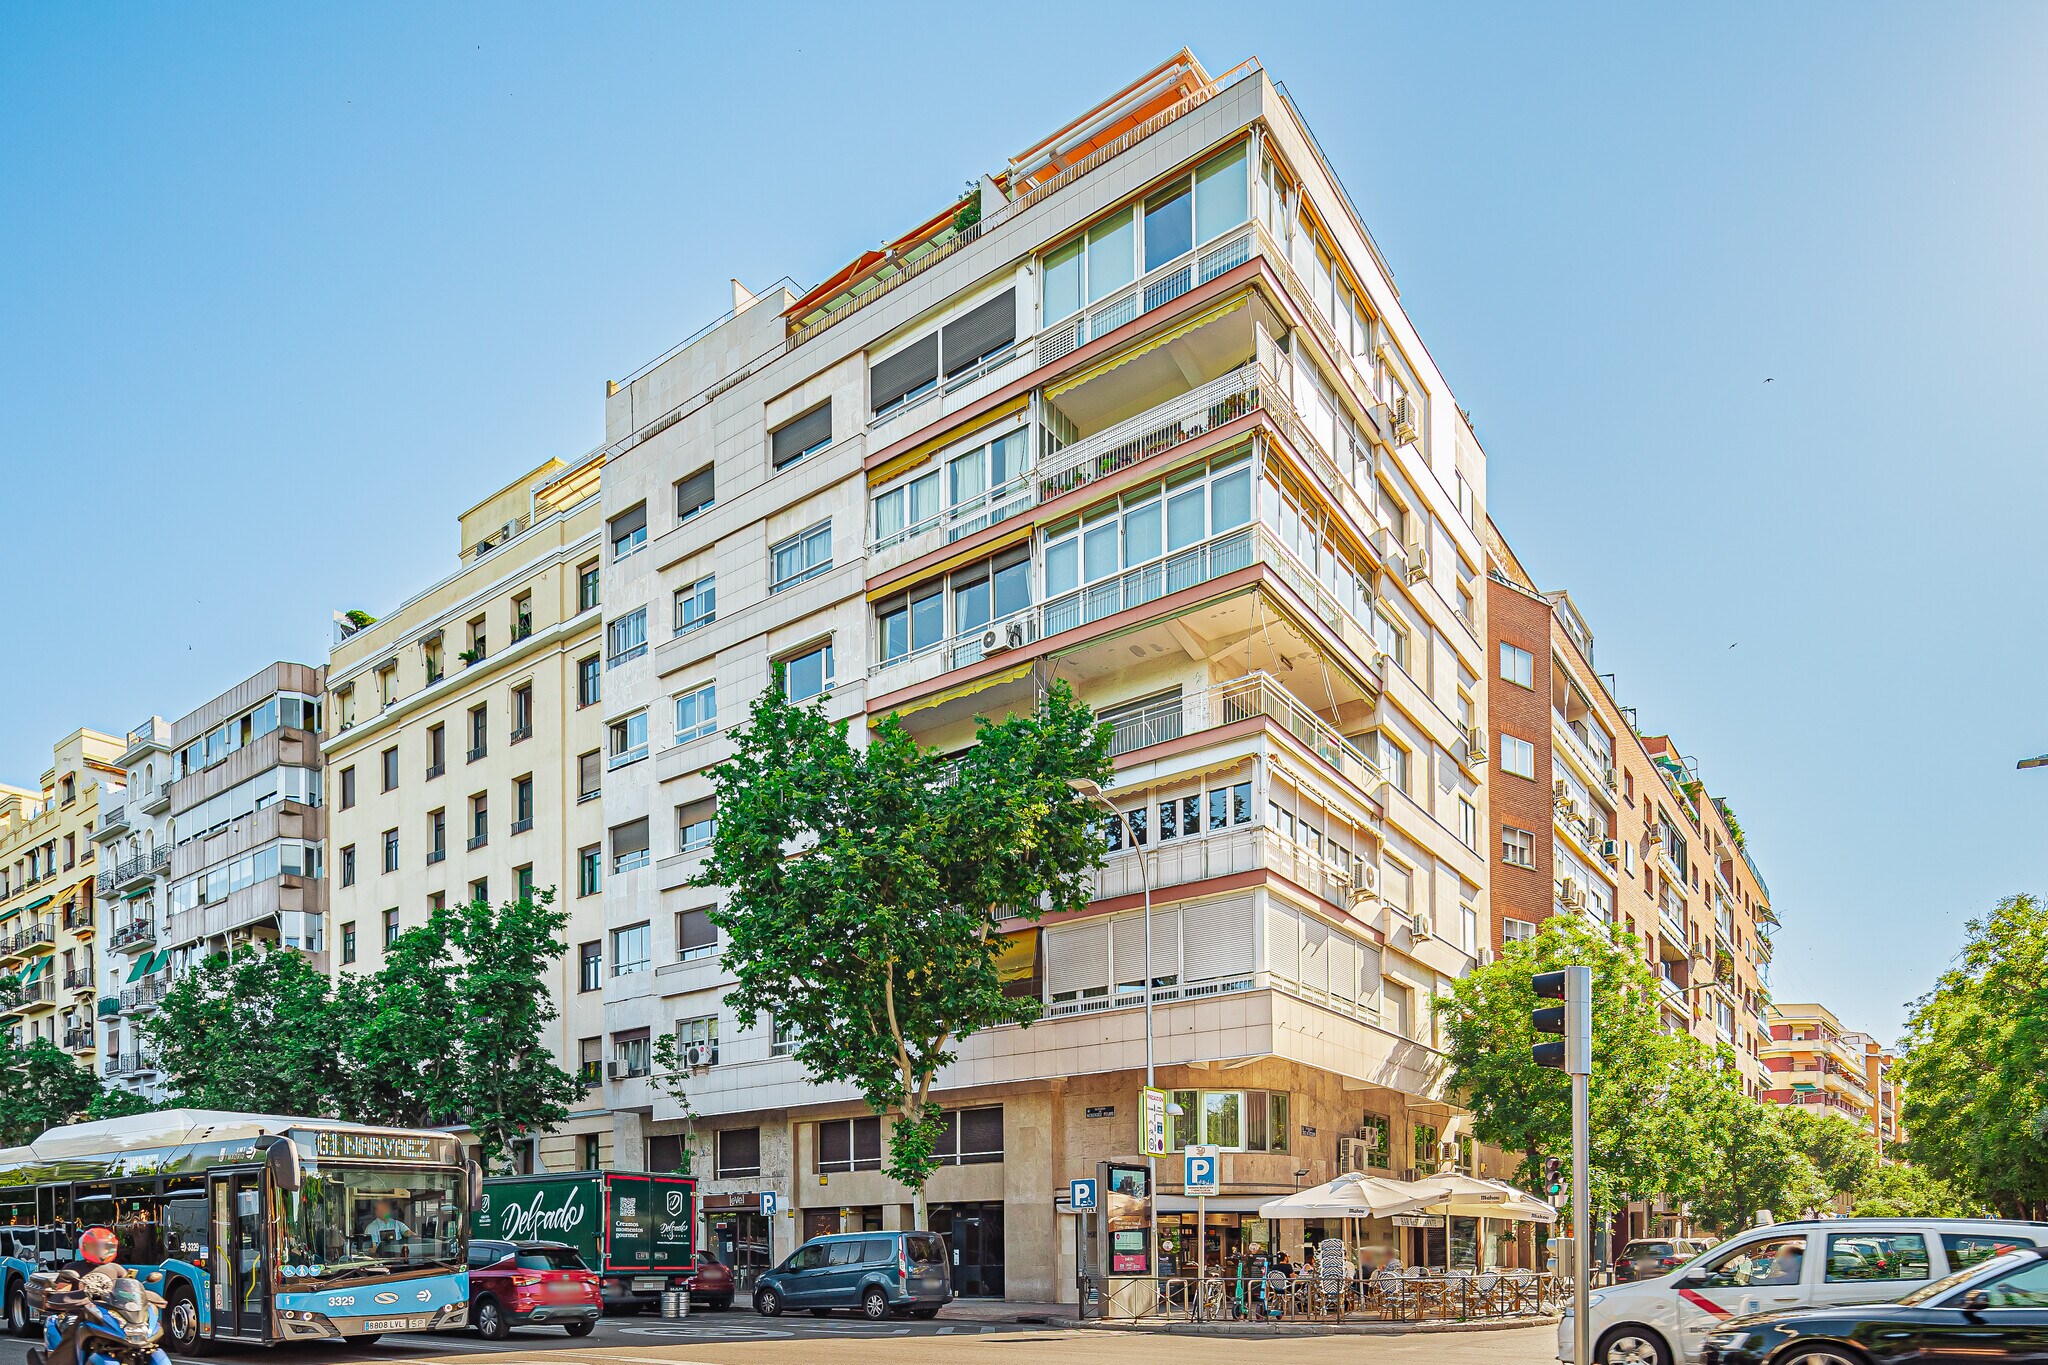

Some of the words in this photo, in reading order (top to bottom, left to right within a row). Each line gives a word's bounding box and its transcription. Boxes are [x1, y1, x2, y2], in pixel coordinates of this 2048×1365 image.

[317, 1133, 340, 1155] 61
[344, 1136, 430, 1158] NARVAEZ
[1192, 1160, 1210, 1183] P
[763, 1195, 774, 1215] P
[1075, 1184, 1090, 1206] P
[501, 1186, 584, 1241] Delgado
[659, 1221, 688, 1241] Delgado
[187, 1242, 200, 1252] 3329
[328, 1295, 355, 1307] 3329
[369, 1321, 388, 1331] 8808
[389, 1320, 404, 1329] LVL
